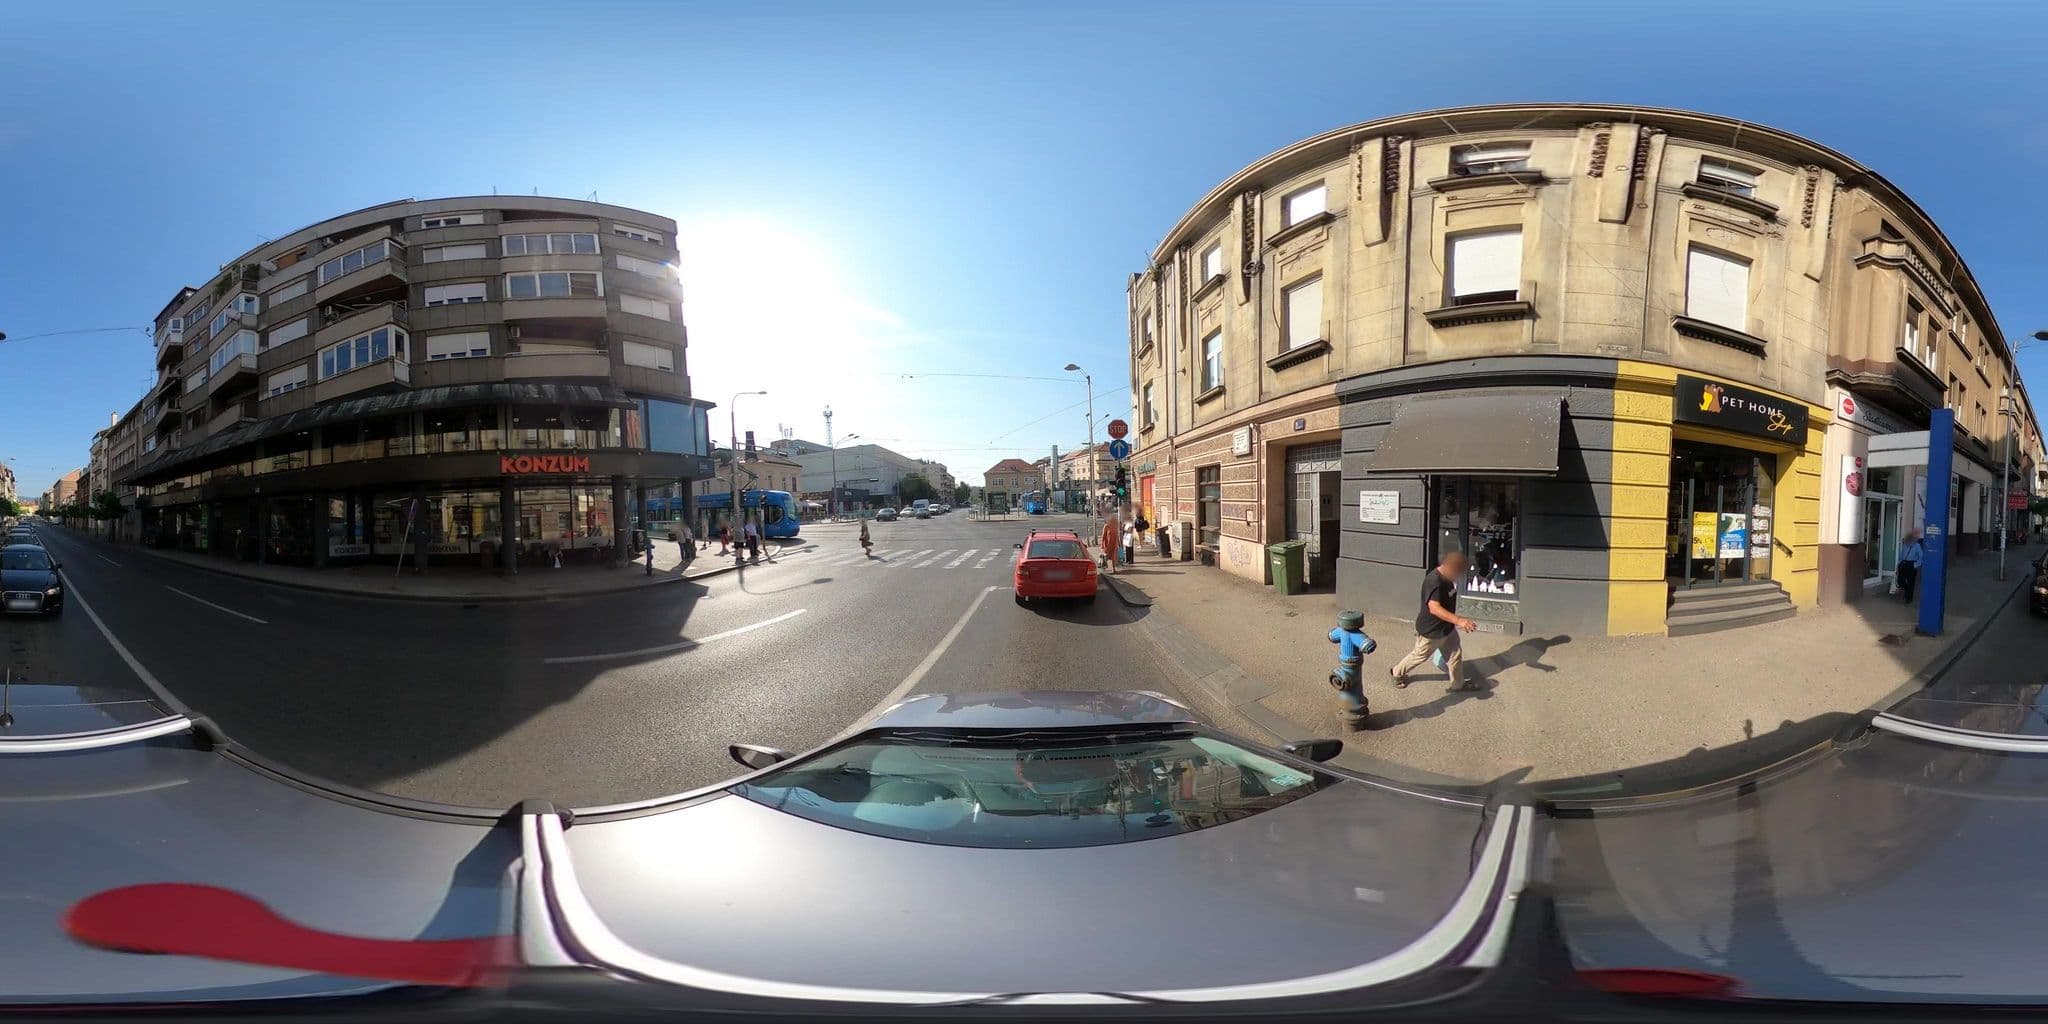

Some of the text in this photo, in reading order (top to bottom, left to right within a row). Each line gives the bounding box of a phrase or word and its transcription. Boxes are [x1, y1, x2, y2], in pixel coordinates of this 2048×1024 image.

[1722, 396, 1784, 419] PET HOME
[1110, 425, 1127, 434] STOP
[501, 455, 590, 474] KONZUM
